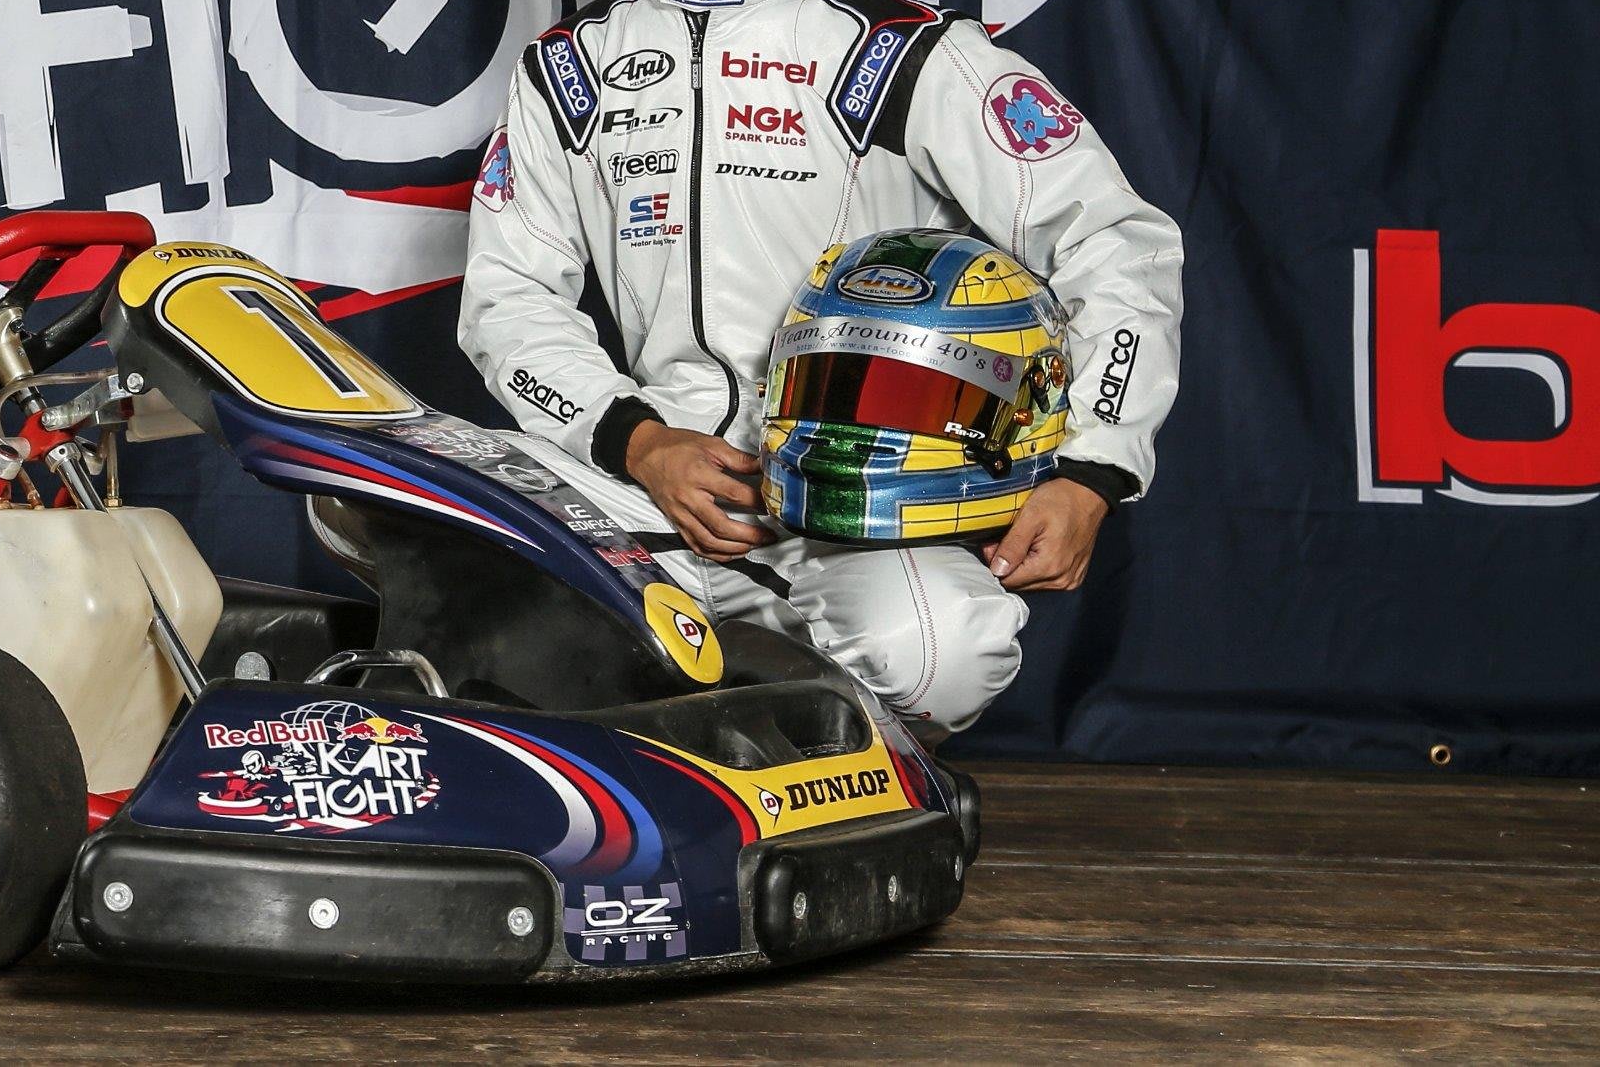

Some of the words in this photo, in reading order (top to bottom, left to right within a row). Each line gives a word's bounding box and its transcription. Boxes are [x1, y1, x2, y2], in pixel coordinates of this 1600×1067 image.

[547, 41, 590, 111] sparco
[608, 53, 665, 82] Arai
[721, 51, 818, 86] birel
[845, 32, 898, 116] sparco
[727, 104, 806, 135] NGK
[725, 131, 763, 143] SPARK
[766, 135, 807, 147] PLUGS
[609, 151, 678, 183] freem
[715, 163, 818, 182] DUNLOP
[173, 248, 258, 262] DUNLO
[863, 288, 897, 296] HELMET
[220, 286, 367, 397] 1
[780, 326, 820, 348] Team
[821, 321, 928, 349] Around
[937, 339, 986, 370] 40's
[567, 519, 618, 531] EDIFICE
[206, 722, 267, 747] Red
[270, 719, 328, 743] Bull
[318, 743, 428, 778] KART
[292, 779, 416, 819] FIGHT
[785, 769, 890, 810] DUNLOP
[585, 932, 673, 946] RACING
